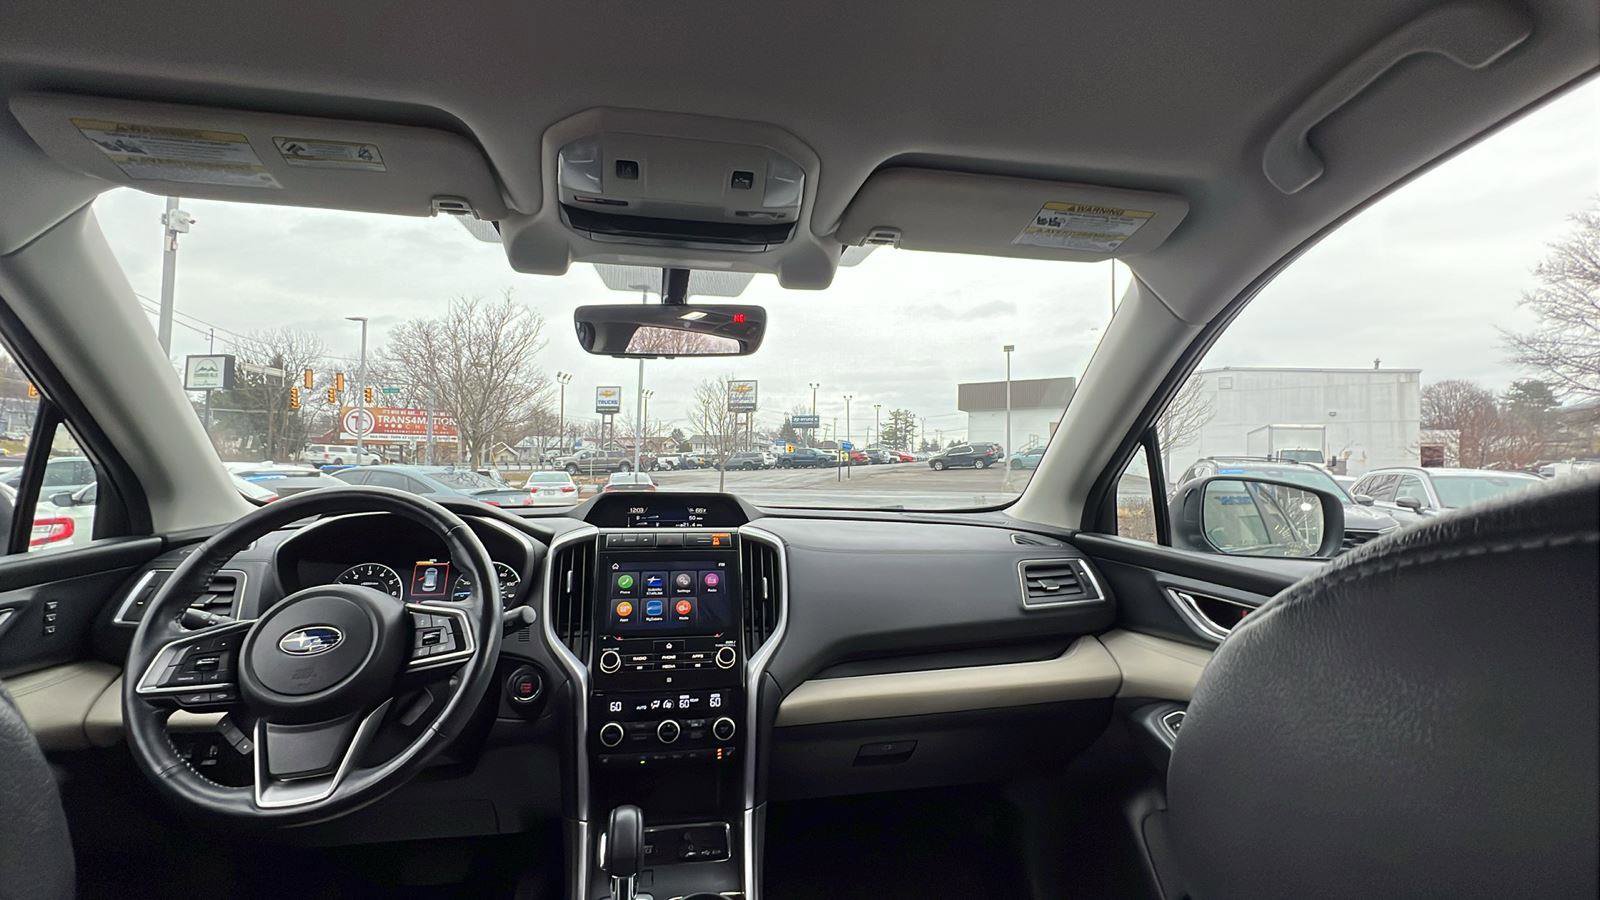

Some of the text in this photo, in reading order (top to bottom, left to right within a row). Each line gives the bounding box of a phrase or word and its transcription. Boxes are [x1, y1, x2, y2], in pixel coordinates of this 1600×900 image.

[1076, 205, 1126, 217] WARNING
[733, 313, 745, 323] NE
[609, 701, 622, 712] 60
[679, 699, 690, 709] 60
[709, 697, 721, 708] 60
